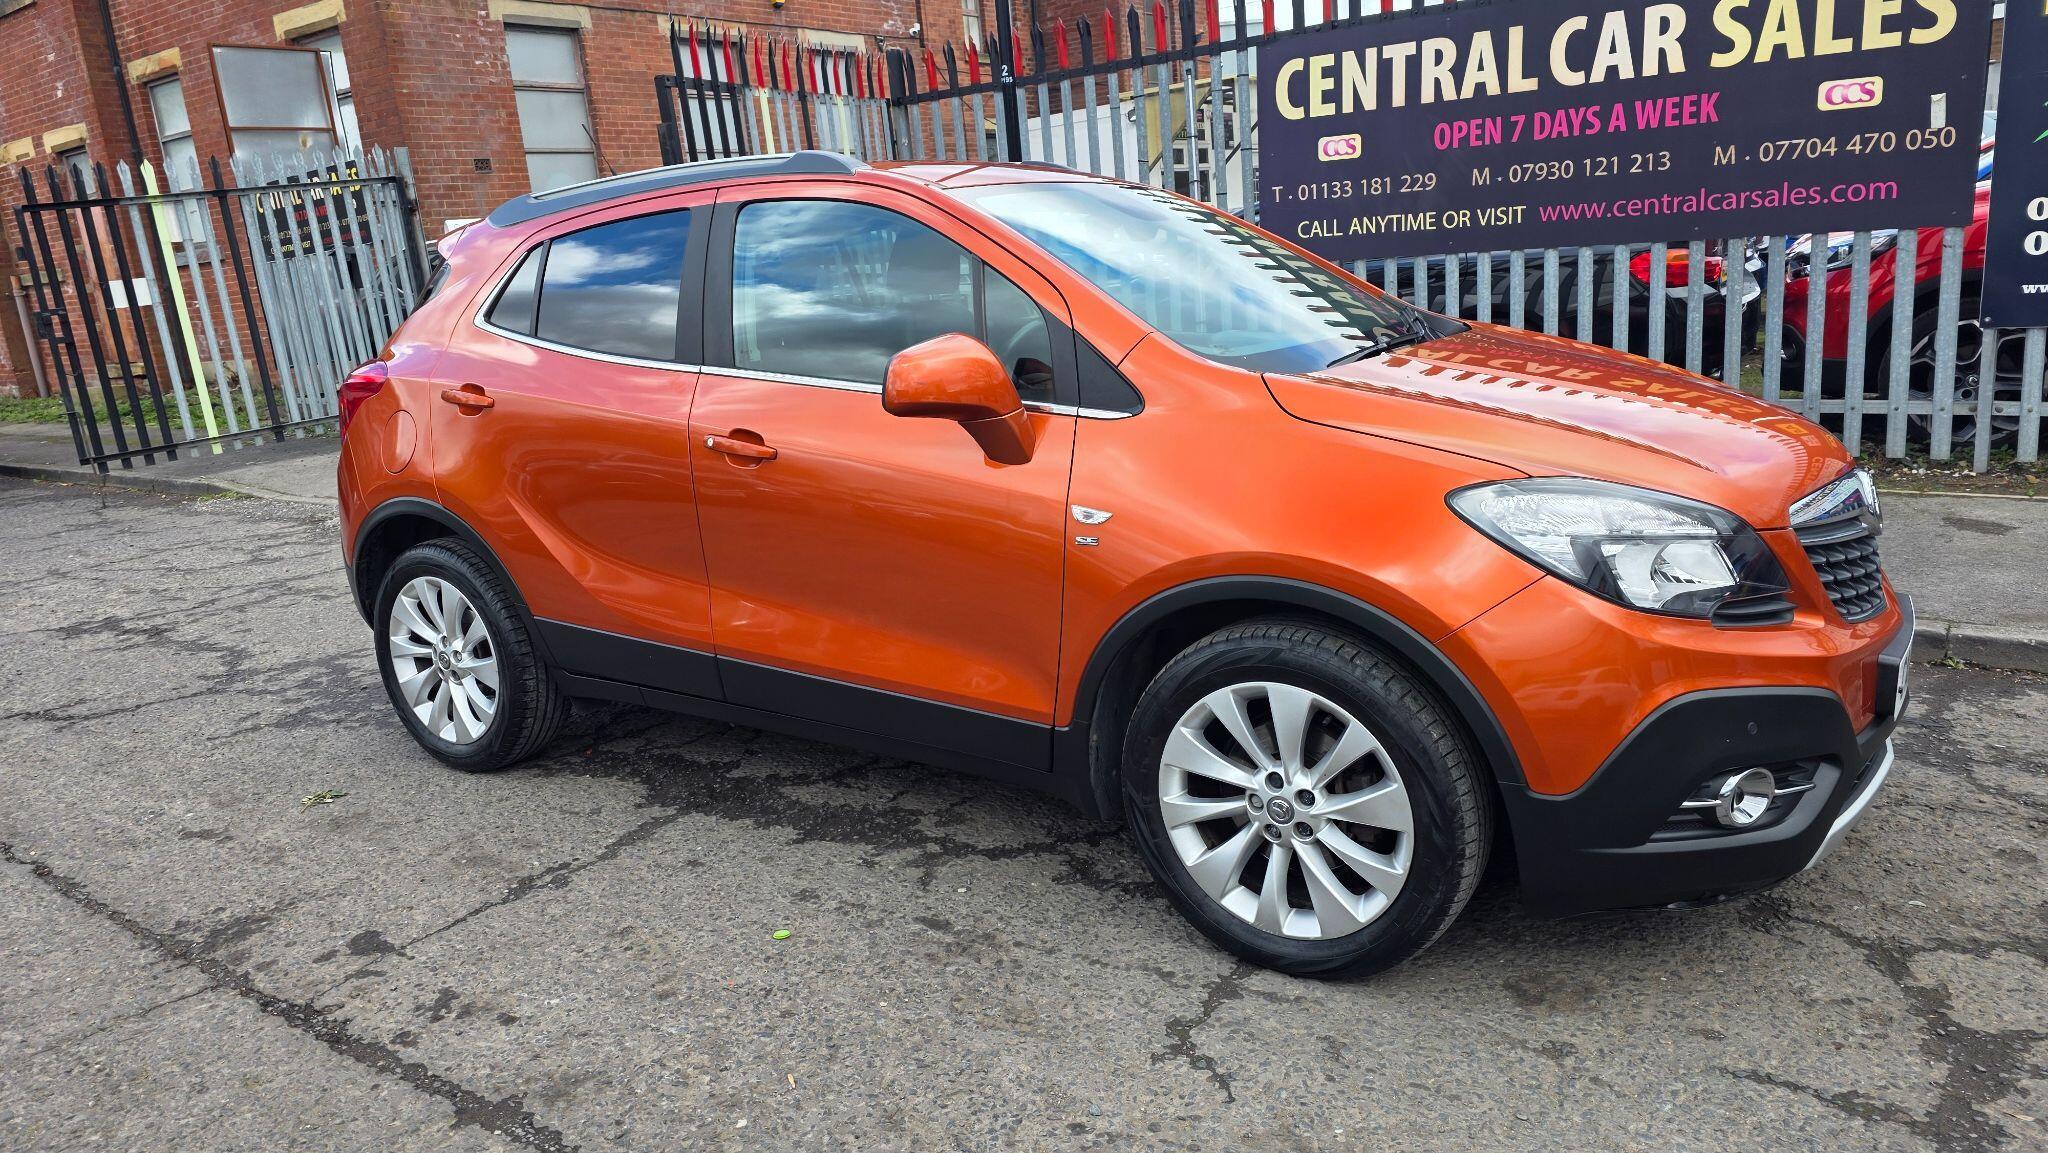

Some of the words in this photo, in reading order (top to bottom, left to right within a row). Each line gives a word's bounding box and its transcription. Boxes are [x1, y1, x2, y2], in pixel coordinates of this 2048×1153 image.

[1275, 25, 1539, 120] CENTRAL
[1549, 3, 1687, 86] CAR
[1710, 0, 1958, 68] SALES
[1433, 116, 1502, 151] OPEN
[1510, 115, 1527, 143] 7
[1533, 105, 1601, 141] DAYS
[1607, 103, 1627, 134] A
[1634, 91, 1721, 130] WEEK
[1825, 79, 1877, 106] CCS
[1298, 179, 1353, 202] 01133
[1361, 177, 1391, 197] 181
[1400, 172, 1437, 193] 229
[1509, 160, 1574, 184] 07930
[1584, 155, 1619, 177] 121
[1629, 150, 1672, 174] 213
[1759, 135, 1838, 163] 07704
[1847, 131, 1896, 156] 470
[1905, 126, 1957, 151] 050
[1322, 137, 1357, 158] CCS
[1298, 219, 1343, 239] CALL
[1349, 210, 1437, 235] ANYTIME
[1443, 210, 1471, 229] OR
[1477, 205, 1527, 227] VISIT
[1539, 180, 1899, 222] www.centralcarsales.com
